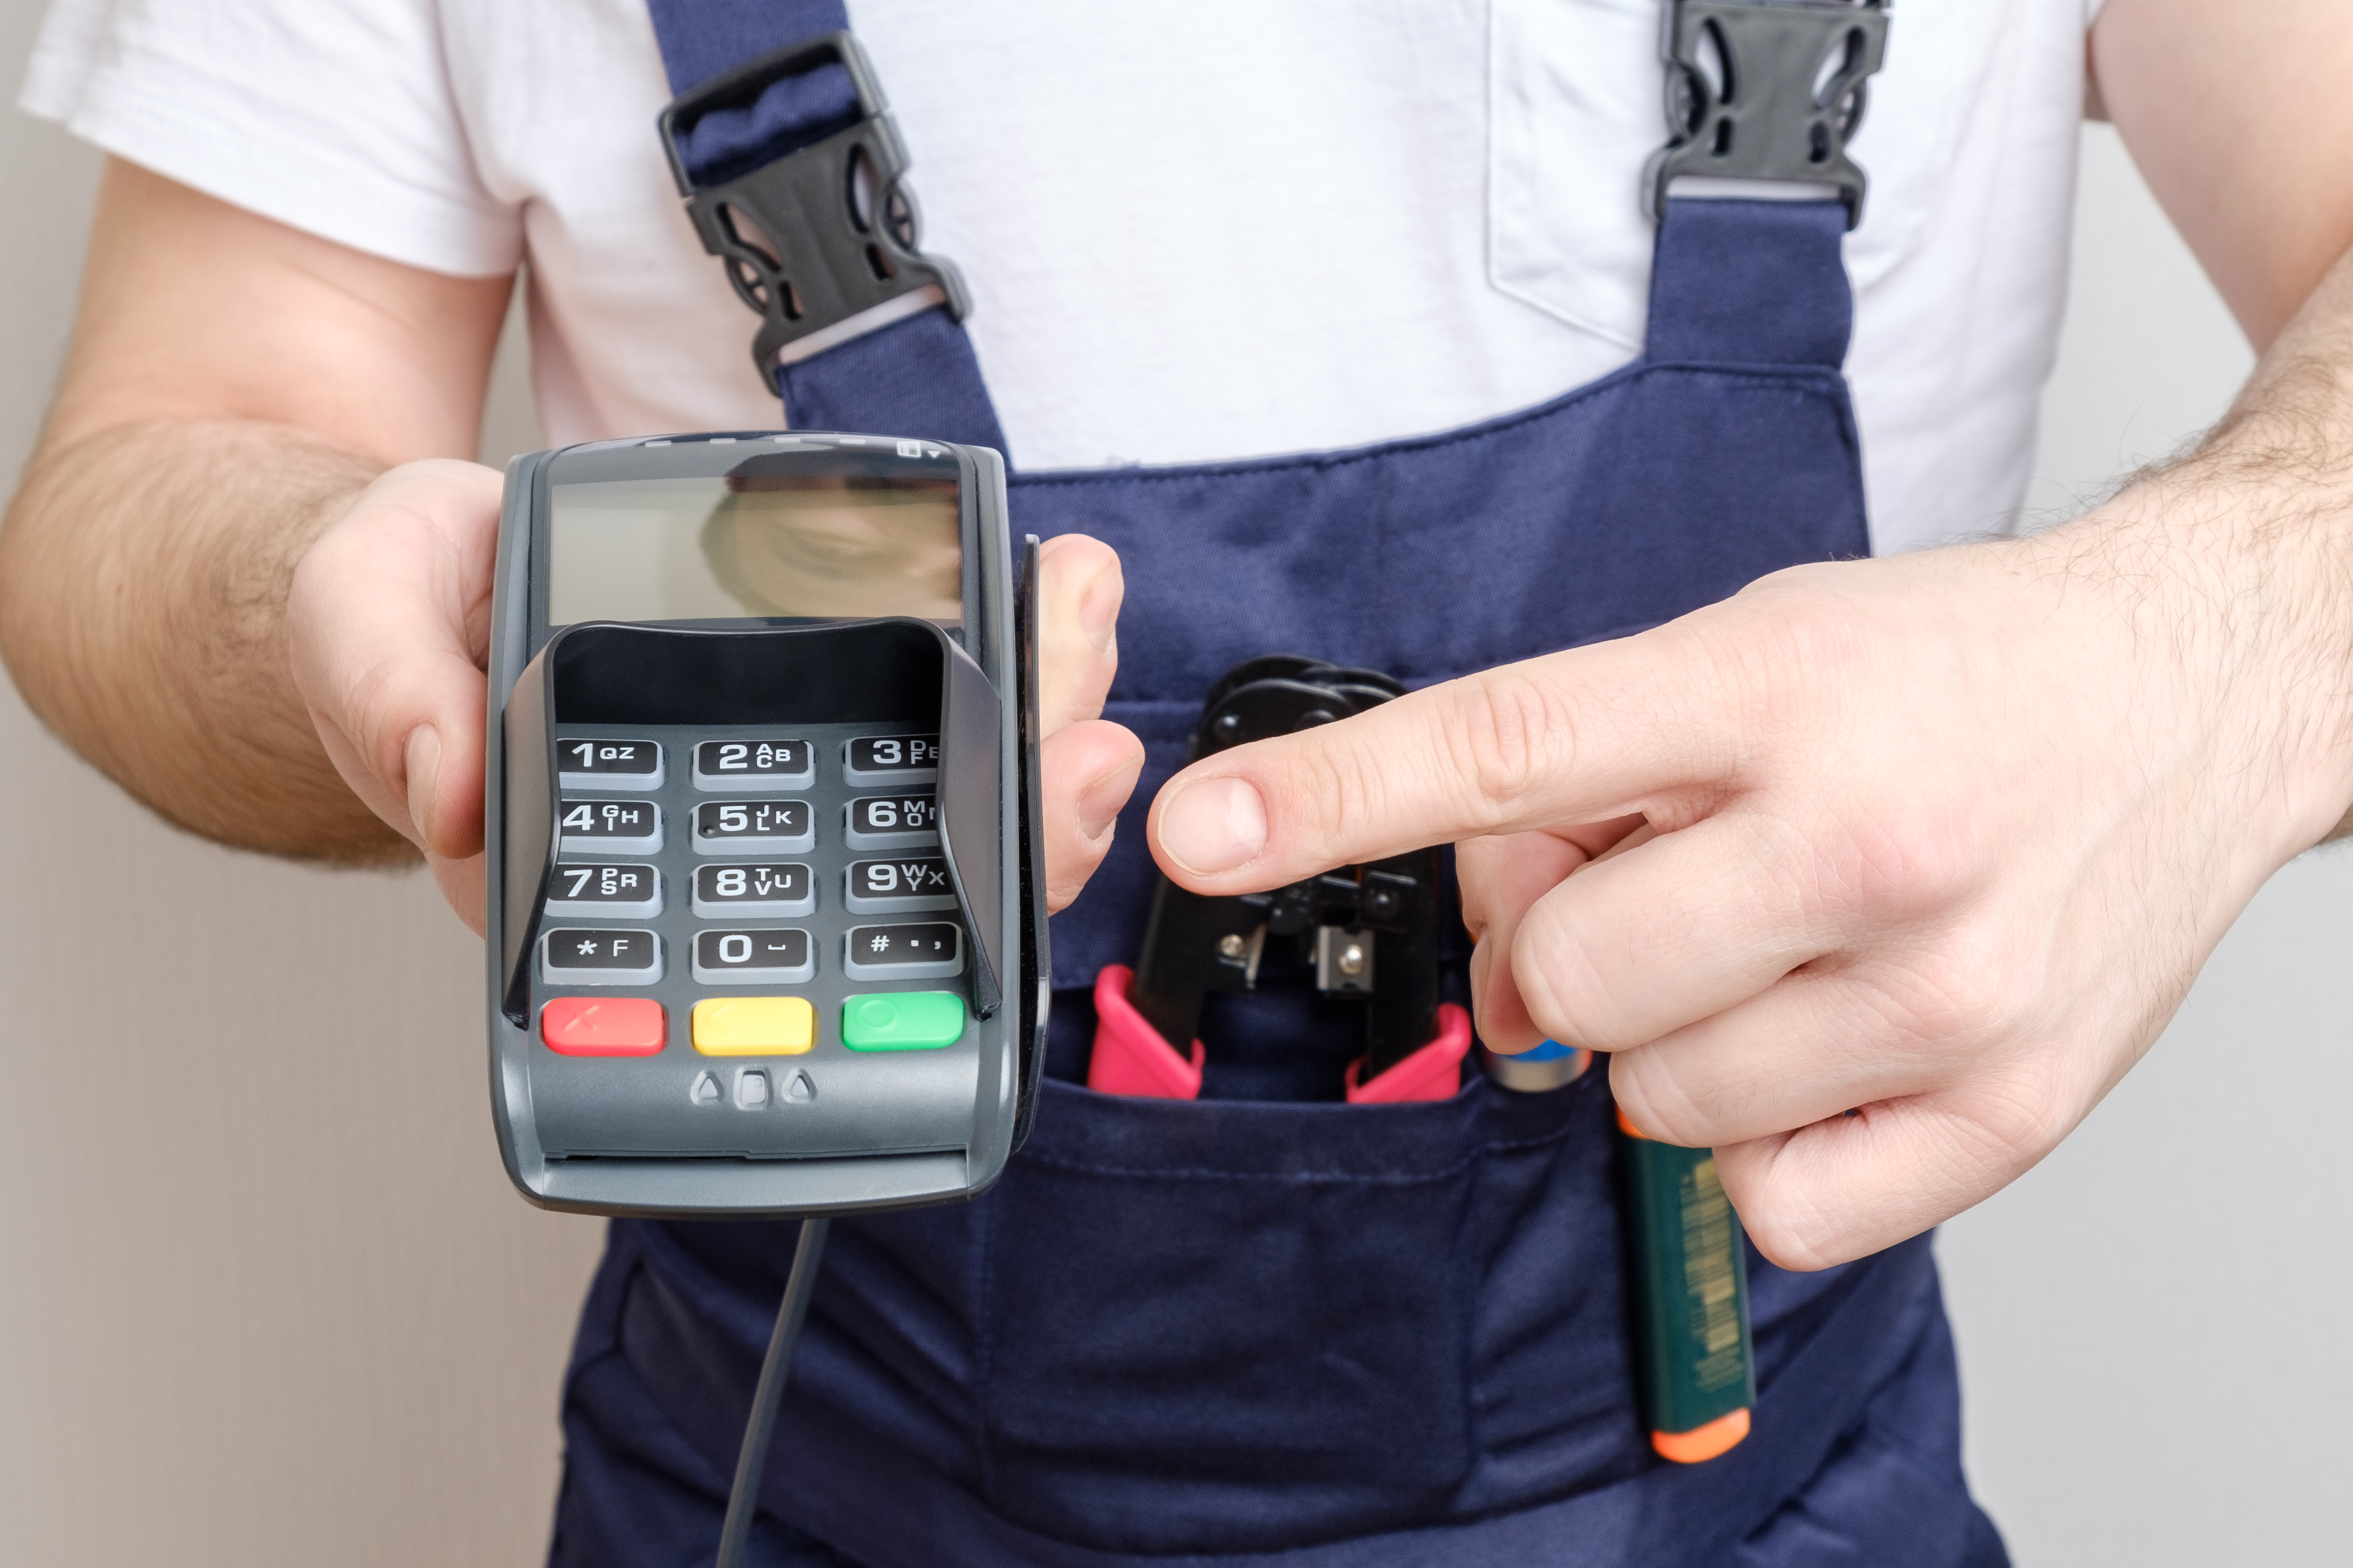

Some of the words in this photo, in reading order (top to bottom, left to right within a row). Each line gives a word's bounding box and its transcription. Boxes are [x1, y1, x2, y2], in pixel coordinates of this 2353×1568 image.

[572, 743, 593, 767] 1
[600, 748, 635, 759] QZ
[719, 744, 748, 769] 2
[873, 740, 902, 764] 3
[562, 805, 595, 831] 4
[719, 805, 748, 832] 5
[868, 801, 897, 826] 6
[563, 869, 592, 897] 7
[716, 869, 747, 896] 8
[868, 864, 897, 891] 9
[613, 939, 629, 957] F
[719, 934, 752, 963] 0
[870, 935, 890, 952] #
